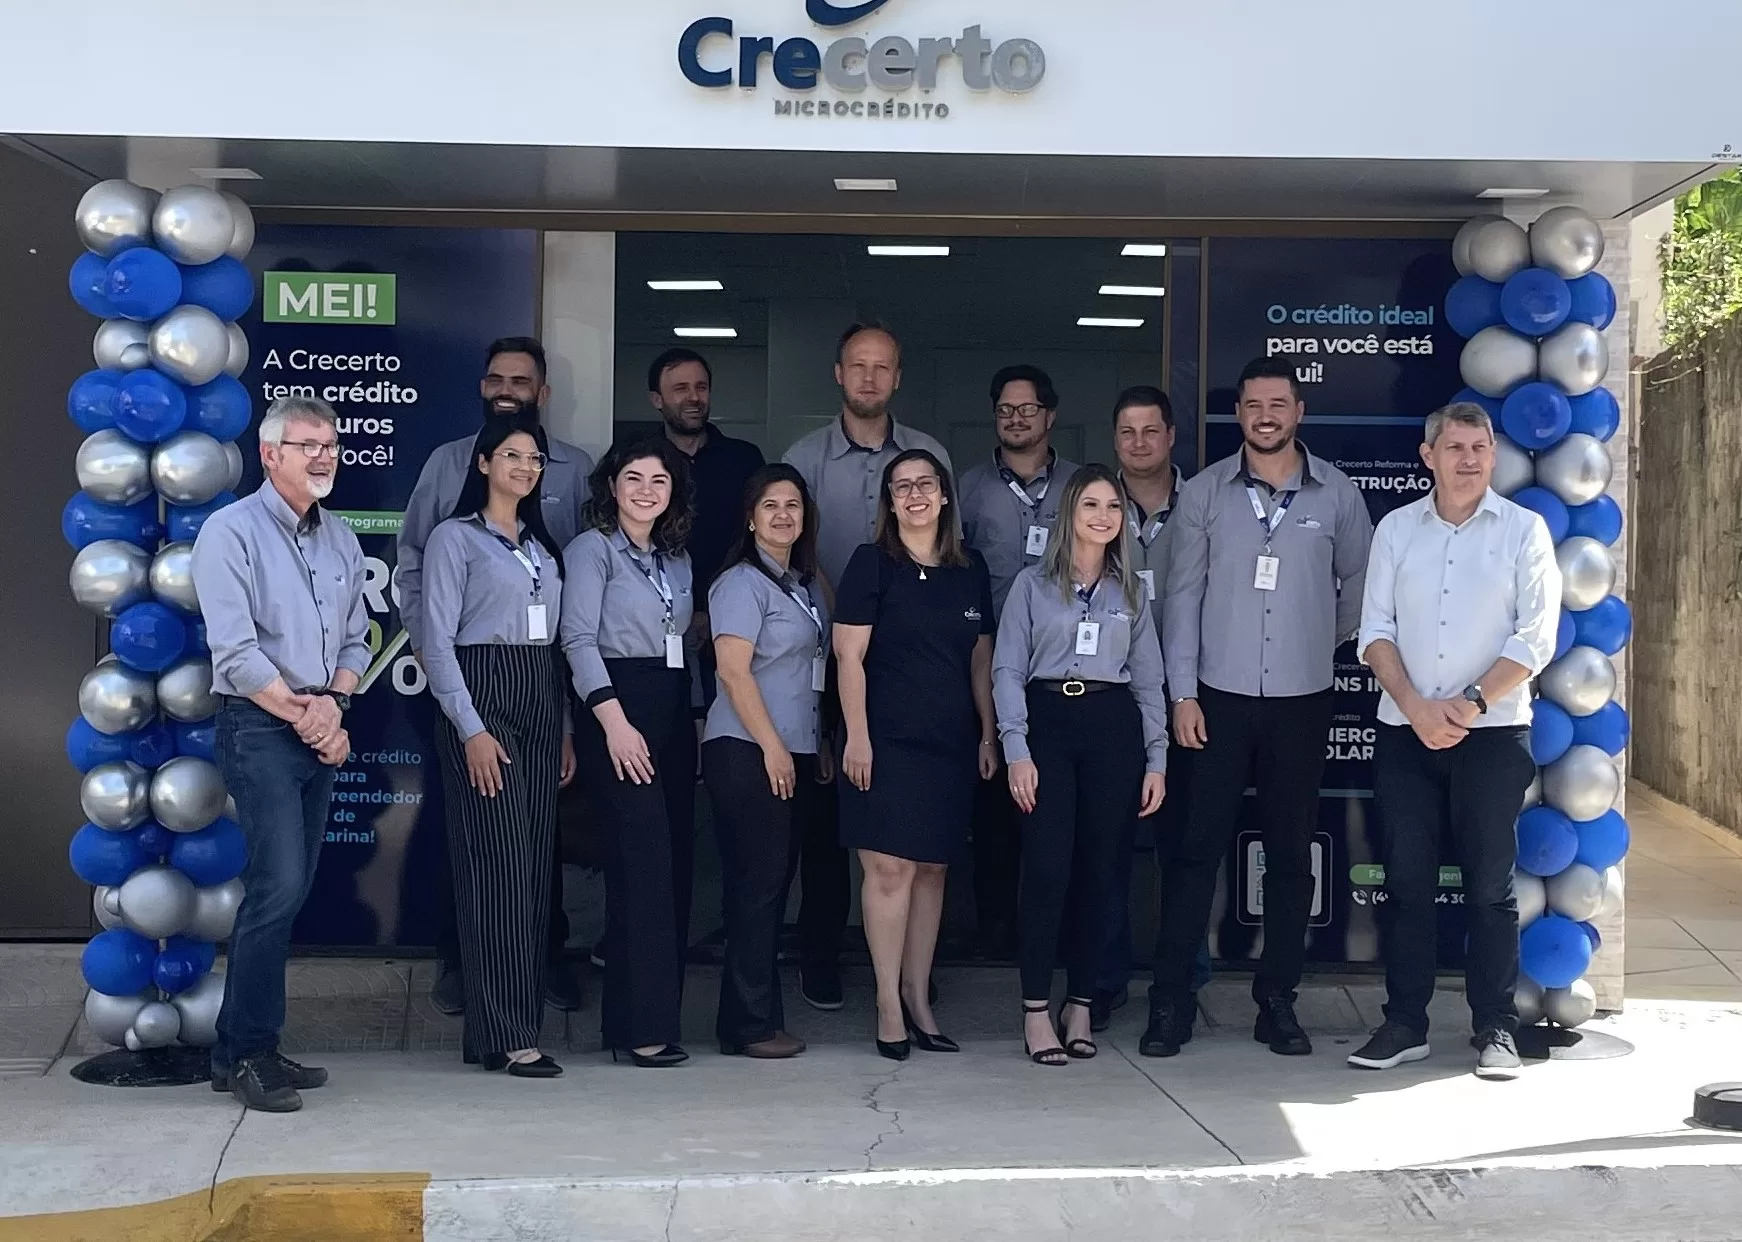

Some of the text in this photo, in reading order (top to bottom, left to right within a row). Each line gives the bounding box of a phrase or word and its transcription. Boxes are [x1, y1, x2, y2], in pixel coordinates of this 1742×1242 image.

[677, 16, 1046, 93] Crecerto
[774, 98, 950, 119] MICROCRÉDITO
[279, 282, 377, 318] MEI!
[1267, 303, 1434, 325] O crédito ideal
[1267, 334, 1433, 357] para você está
[263, 349, 401, 372] A Crecerto
[1296, 362, 1324, 383] ui!
[263, 381, 418, 404] tem crédito
[336, 417, 394, 435] uros
[340, 445, 394, 466] ocê!
[1336, 460, 1373, 469] Crecerto
[1374, 460, 1412, 469] Reforma
[1334, 677, 1362, 692] NS
[362, 749, 422, 765] crédito
[331, 789, 423, 805] reendedor
[333, 809, 356, 823] de
